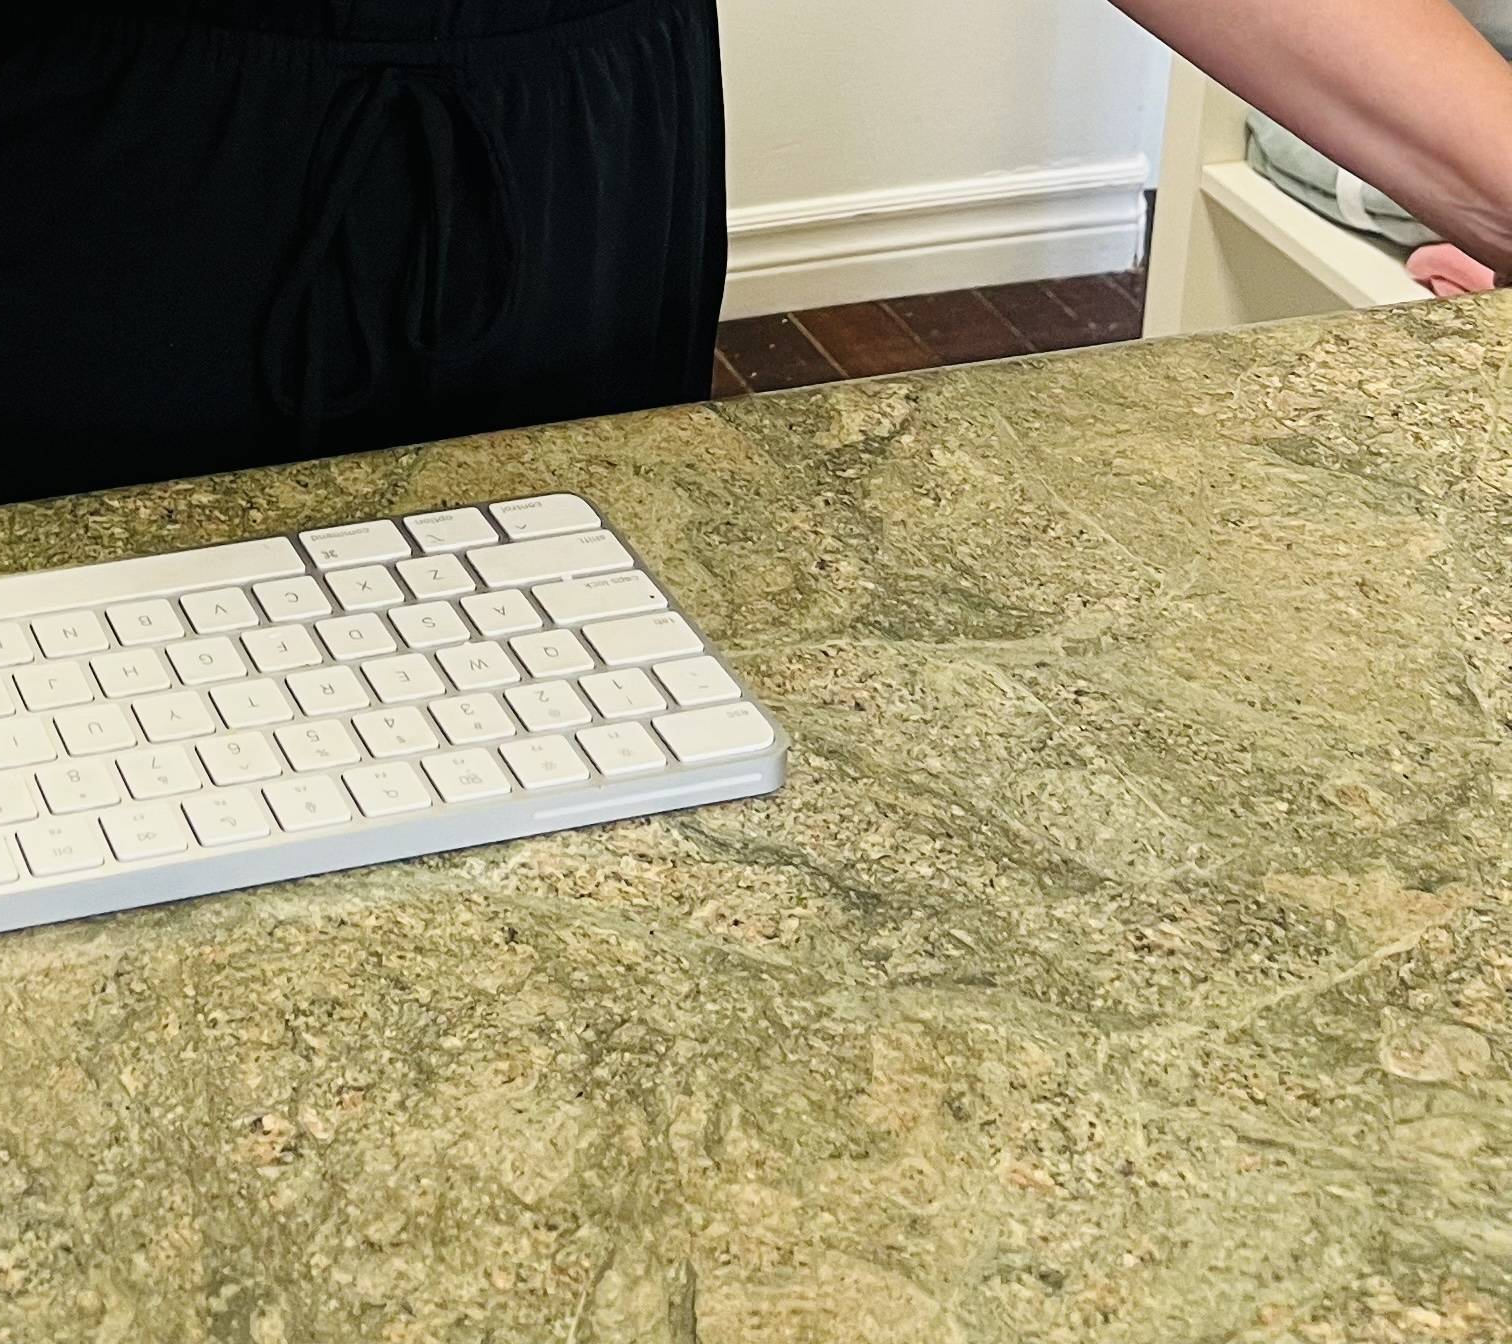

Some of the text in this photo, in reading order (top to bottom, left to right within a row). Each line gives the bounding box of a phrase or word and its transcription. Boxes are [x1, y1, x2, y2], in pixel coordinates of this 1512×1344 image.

[429, 569, 440, 580] Z
[356, 581, 372, 592] X
[284, 592, 298, 603] C
[214, 604, 227, 615] V
[493, 606, 507, 617] A
[138, 616, 152, 626] B
[422, 617, 436, 628] S
[62, 627, 77, 638] N
[349, 630, 363, 640] D
[277, 642, 288, 654] F
[542, 647, 559, 658] Q
[199, 654, 213, 665] G
[469, 659, 488, 671] W
[122, 666, 138, 677] H
[395, 671, 410, 681] E
[48, 679, 57, 690] J
[320, 684, 334, 695] R
[613, 680, 622, 689] 1
[537, 691, 549, 702] 2
[245, 697, 258, 708] T
[169, 709, 181, 721] Y
[460, 704, 474, 715] 3
[87, 722, 103, 735] U
[384, 718, 395, 728] 4
[306, 730, 319, 742] 5
[228, 743, 241, 756] 6
[150, 756, 159, 769] 7
[67, 770, 80, 783] 8
